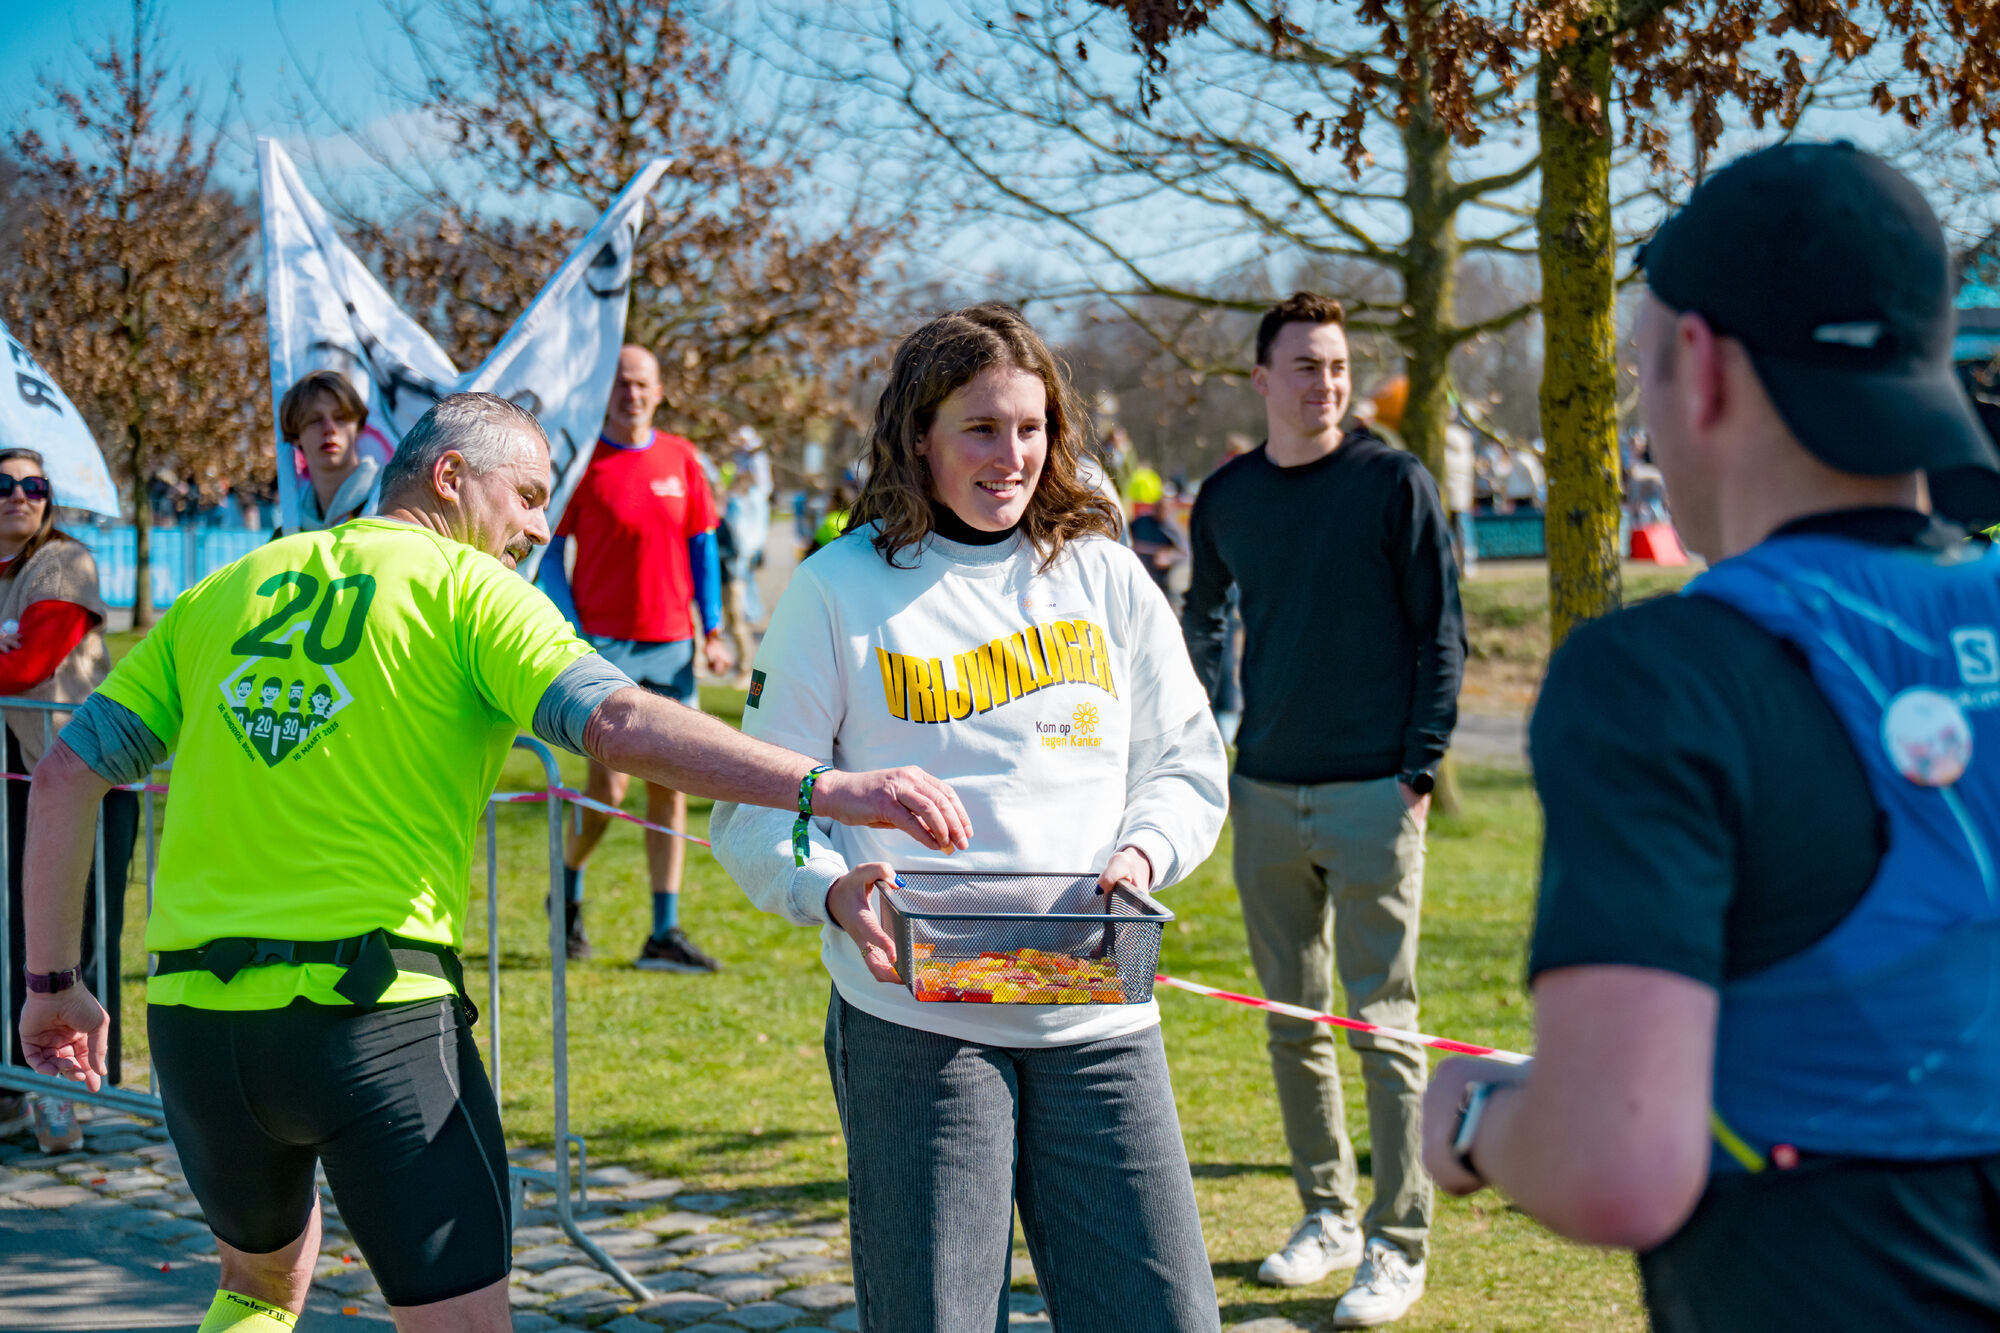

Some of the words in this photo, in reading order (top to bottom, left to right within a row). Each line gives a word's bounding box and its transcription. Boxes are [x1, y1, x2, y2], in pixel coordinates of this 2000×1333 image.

[231, 571, 377, 665] 20
[875, 620, 1119, 724] VRIJWILLIGER
[255, 715, 273, 733] 20
[282, 718, 299, 736] 30
[1036, 721, 1056, 733] Kom
[1059, 724, 1071, 736] op
[300, 732, 322, 756] MAART
[1041, 735, 1067, 749] tegen
[1070, 735, 1102, 747] Kanker
[227, 1293, 287, 1321] Kalenji
